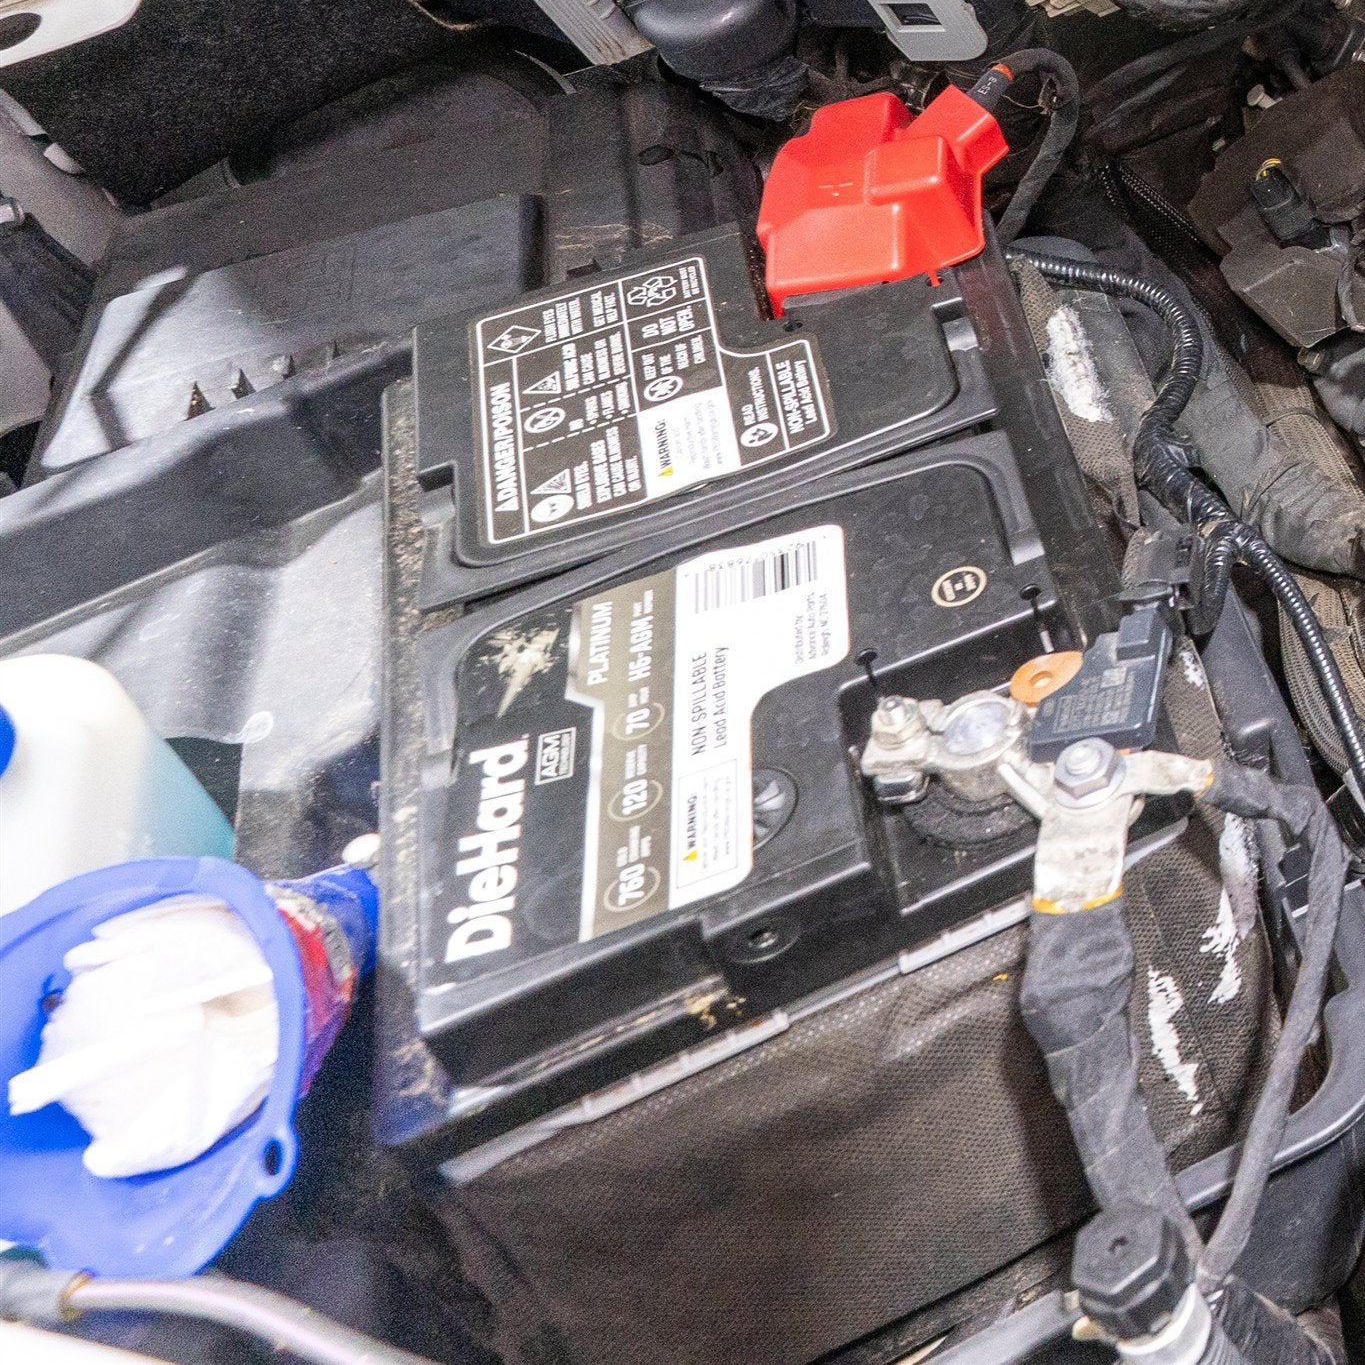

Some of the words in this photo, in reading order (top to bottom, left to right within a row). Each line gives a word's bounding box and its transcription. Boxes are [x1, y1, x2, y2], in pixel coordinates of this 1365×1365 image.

[641, 323, 659, 338] DO
[659, 316, 677, 335] NOT
[676, 305, 695, 332] OPEN.
[794, 360, 809, 388] Battery
[748, 366, 769, 422] INSTRUCTIONS.
[775, 360, 805, 434] NON-SPILLABLE
[797, 386, 813, 404] Acid
[741, 404, 756, 426] READ
[801, 403, 818, 425] Lead
[491, 382, 518, 503] DANGER/POISON
[655, 419, 671, 469] WARNING:
[586, 601, 613, 685] PLATINUM
[628, 615, 654, 682] H6-AGM
[711, 646, 730, 689] Battery
[625, 708, 650, 735] 70
[691, 652, 707, 756] NON-SPILLABLE
[711, 692, 727, 715] Acid
[712, 719, 728, 748] Lead
[541, 735, 561, 777] AGM
[621, 779, 648, 815] 120
[618, 863, 645, 906] 760
